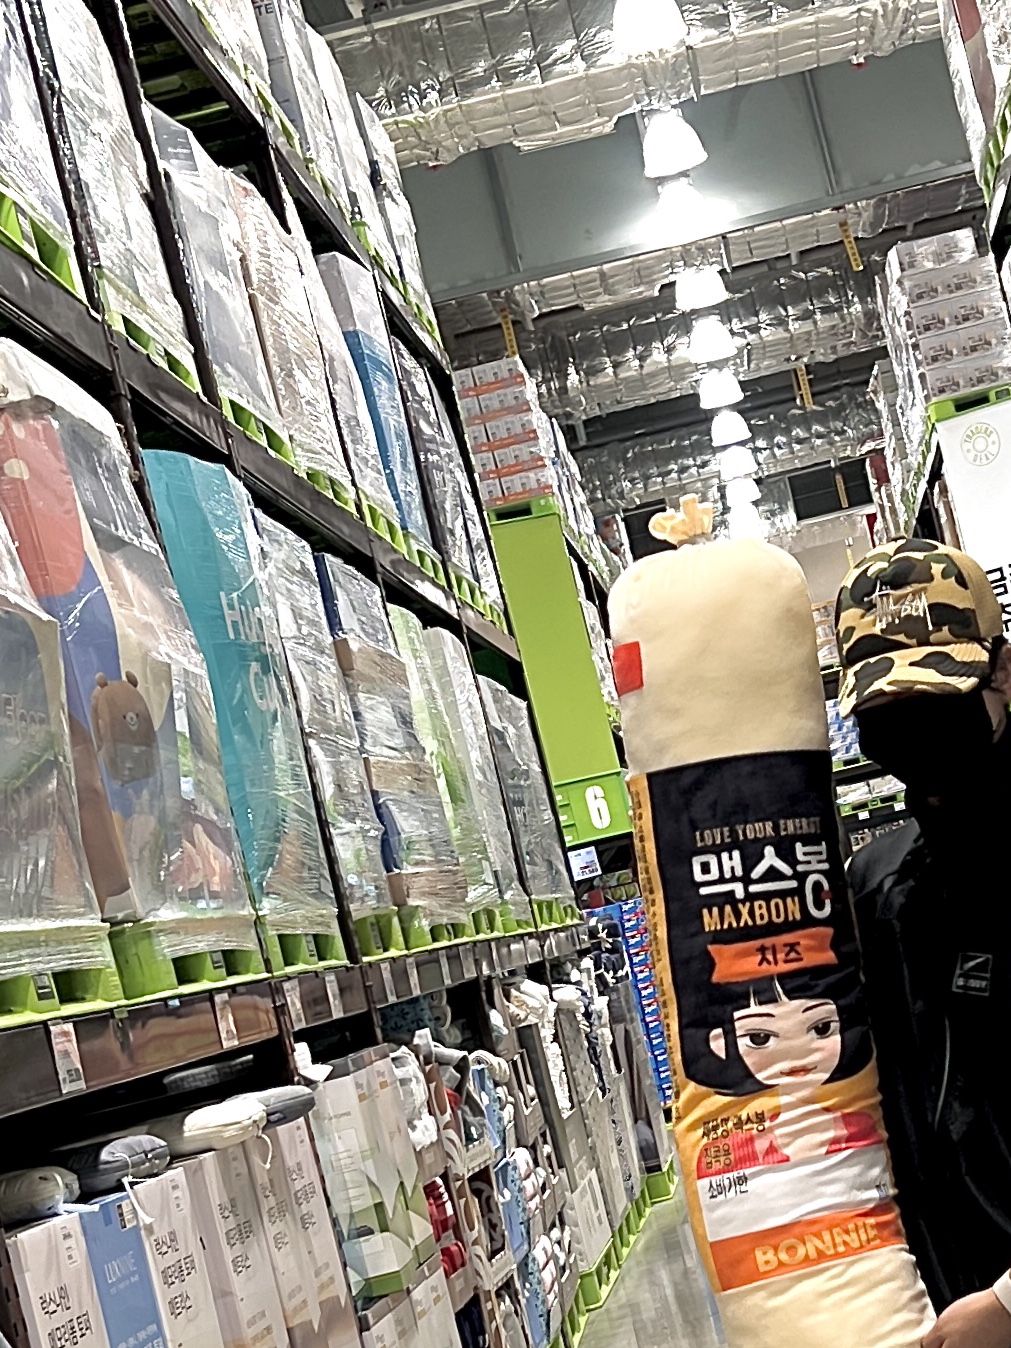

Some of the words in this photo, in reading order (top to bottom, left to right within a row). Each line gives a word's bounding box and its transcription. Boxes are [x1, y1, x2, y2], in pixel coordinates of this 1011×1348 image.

[585, 785, 611, 829] 6
[695, 827, 731, 847] LOVE
[736, 821, 775, 841] YOUR
[692, 841, 832, 919] 맥스봉
[702, 896, 801, 932] MAXBON
[756, 941, 804, 967] 치즈
[707, 1171, 749, 1199] 소비기한
[754, 1218, 881, 1273] BONNIE
